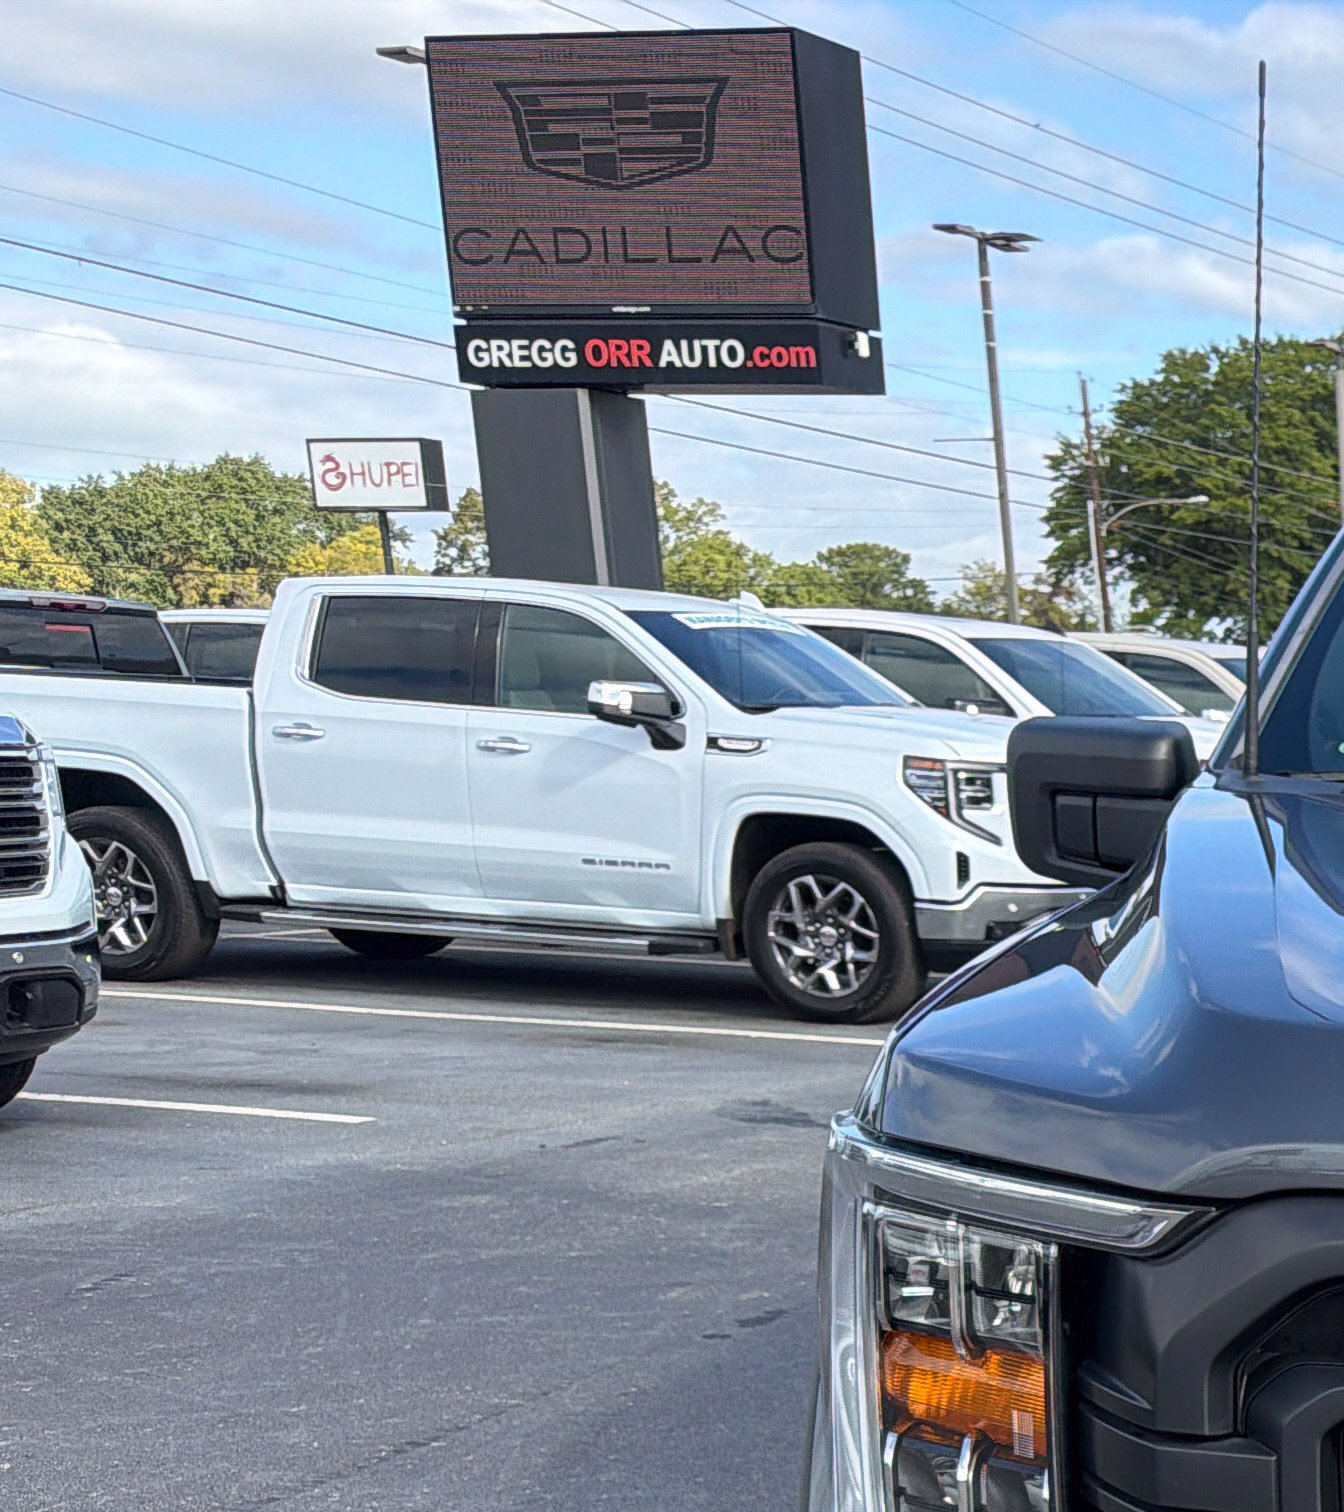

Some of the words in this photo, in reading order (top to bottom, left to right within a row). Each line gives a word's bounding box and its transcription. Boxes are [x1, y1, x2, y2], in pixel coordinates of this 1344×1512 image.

[453, 225, 804, 266] CADILLAC
[467, 339, 577, 368] GREGG
[585, 339, 654, 368] ORR
[658, 339, 818, 368] AUTO.com
[348, 461, 420, 488] HUPEI
